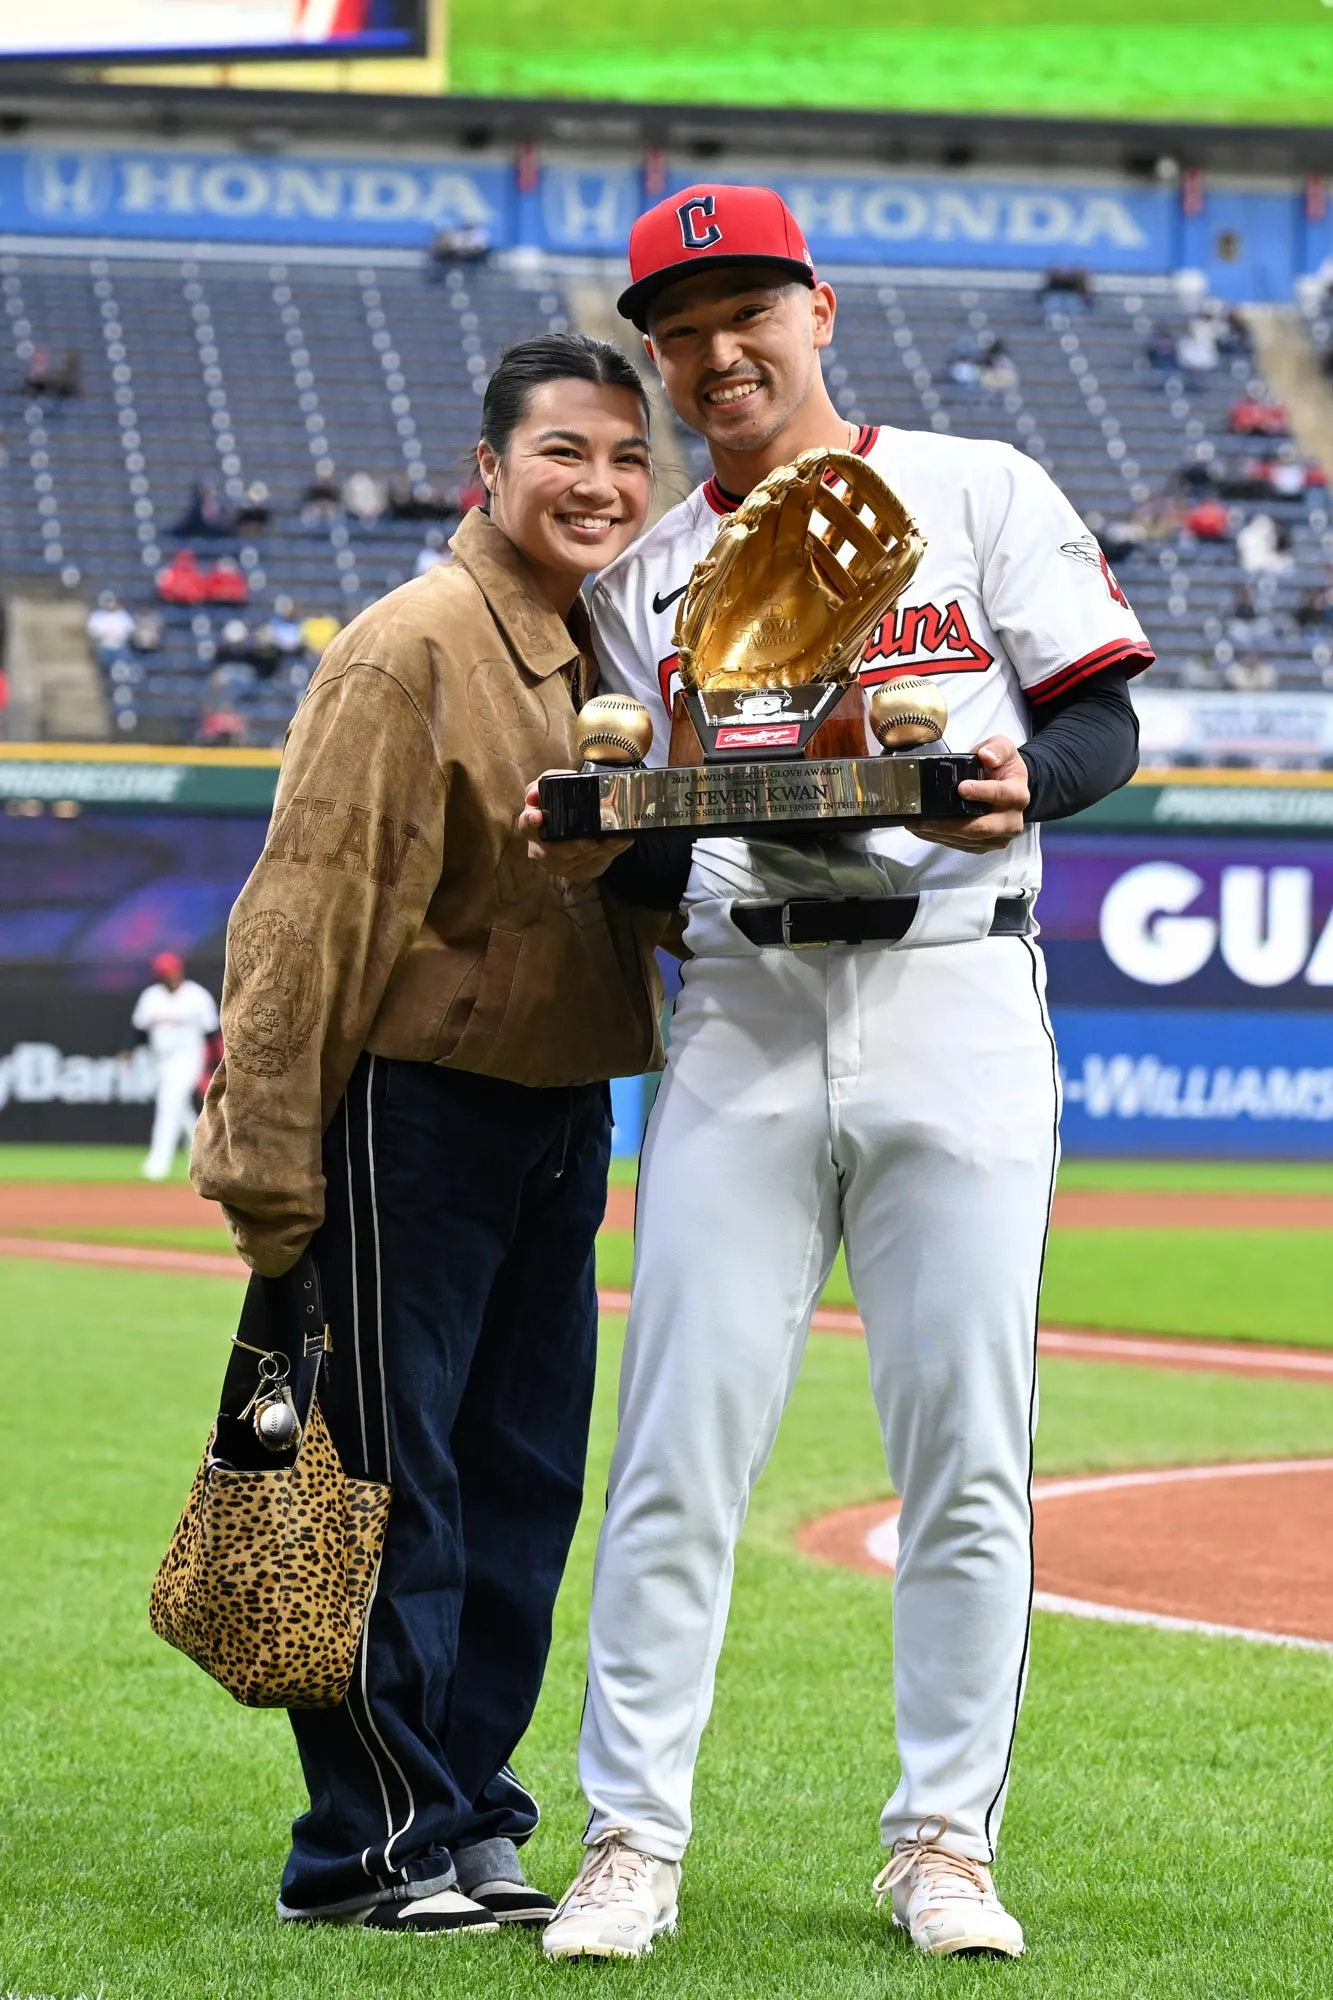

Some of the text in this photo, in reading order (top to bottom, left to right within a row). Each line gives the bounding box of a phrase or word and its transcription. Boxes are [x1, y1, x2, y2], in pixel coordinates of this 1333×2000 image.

[119, 160, 496, 223] HONDA
[789, 186, 1147, 248] HONDA
[676, 195, 723, 250] C
[671, 776, 690, 785] 2024
[742, 771, 769, 780] GOLD
[770, 769, 802, 778] GLOVE
[684, 784, 828, 806] STEVEN KWAN
[633, 811, 684, 822] HONORING
[686, 809, 701, 818] HIS
[702, 807, 753, 817] SELECTION
[768, 804, 787, 813] THE
[789, 803, 821, 812] FINEST
[823, 802, 834, 810] IN
[836, 801, 856, 810] THE
[1100, 861, 1333, 988] GU
